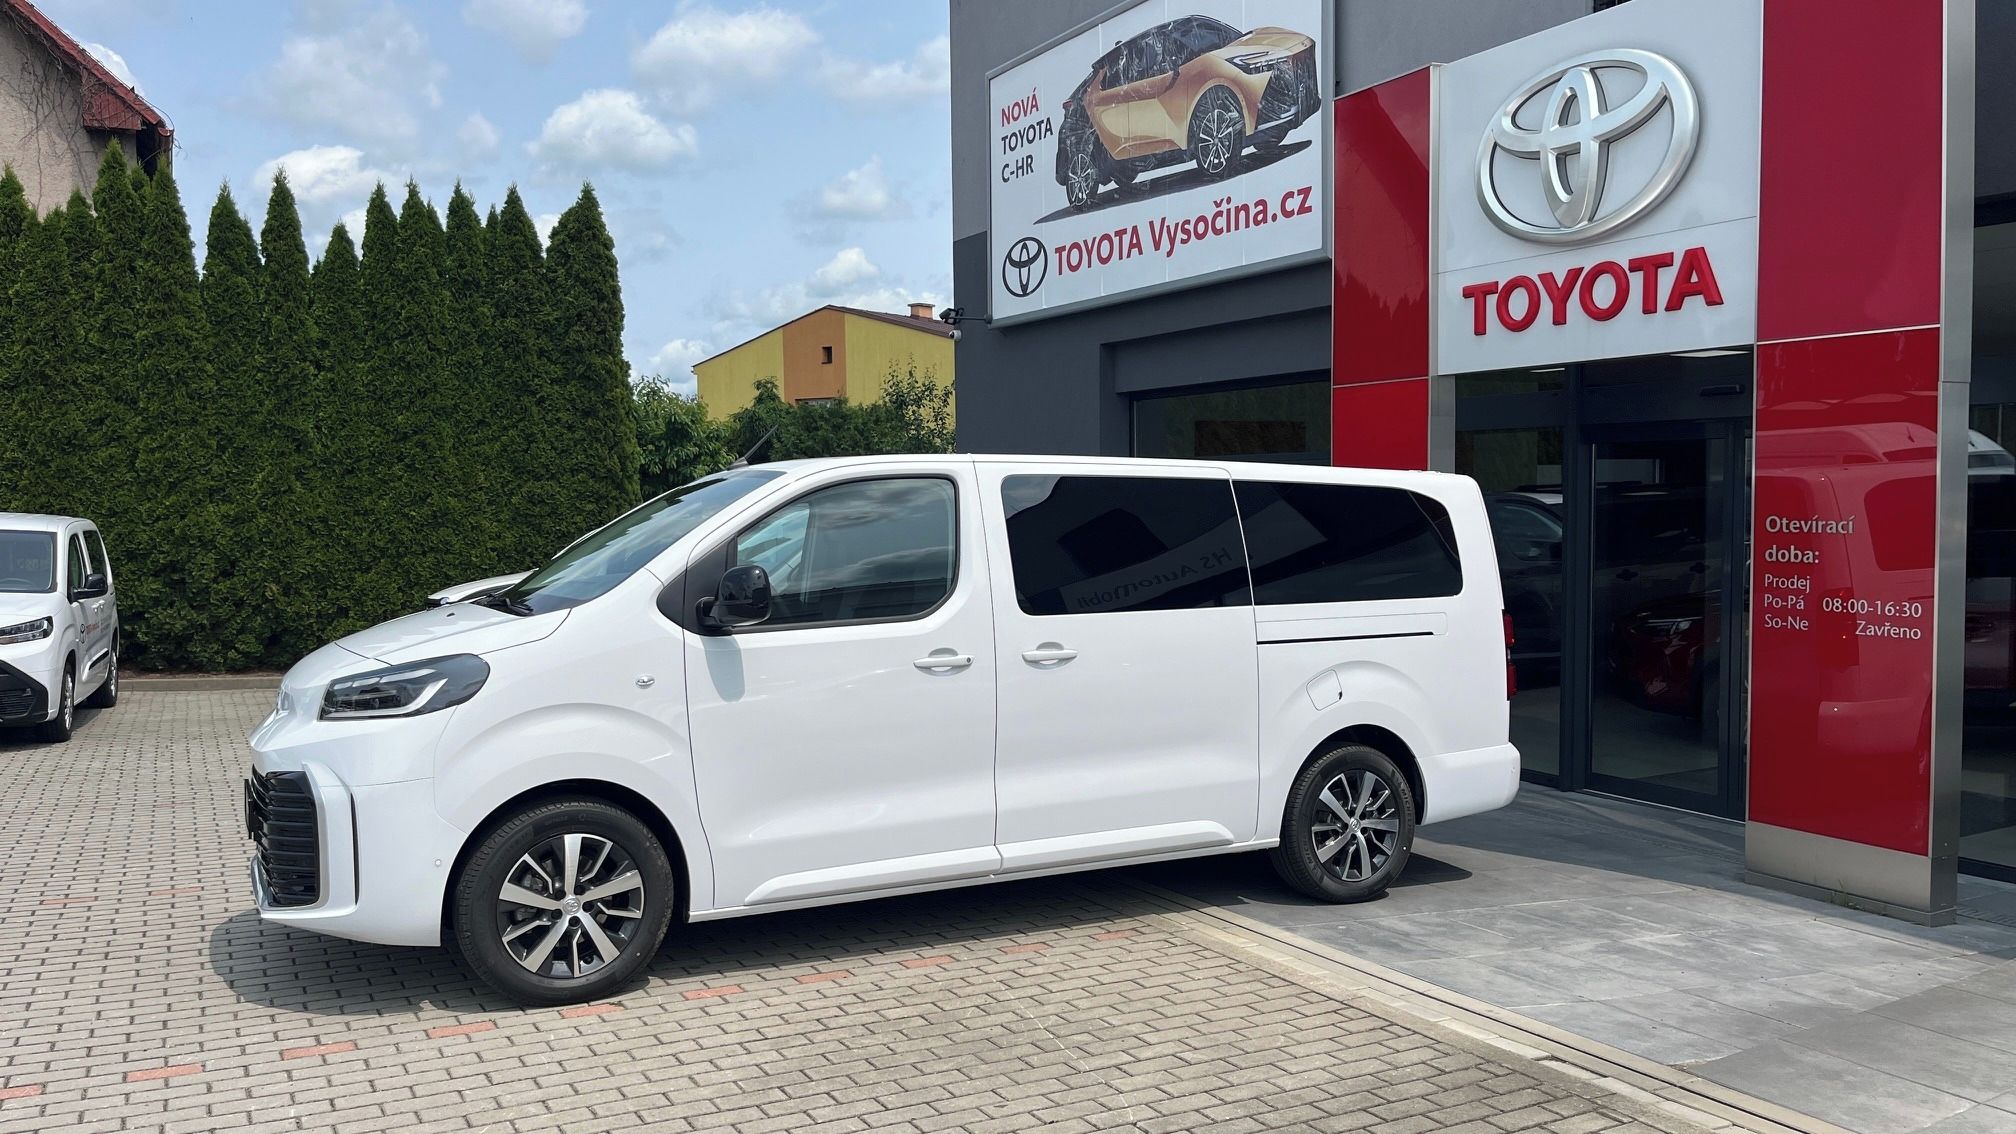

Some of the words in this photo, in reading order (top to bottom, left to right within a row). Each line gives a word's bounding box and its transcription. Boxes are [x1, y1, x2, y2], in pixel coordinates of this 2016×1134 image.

[1001, 87, 1039, 127] NOVÁ
[1001, 117, 1053, 155] TOYOTA
[1001, 156, 1034, 184] C-HR
[1054, 225, 1144, 276] TOYOTA
[1149, 186, 1313, 257] Vysočina.cz
[1462, 246, 1724, 336] TOYOTA
[1765, 515, 1856, 534] Otevírací
[1764, 544, 1820, 564] doba:
[1764, 574, 1811, 594] Prodej
[1764, 593, 1805, 610] Po-Pá
[1822, 597, 1922, 618] 08:00-16:30
[1764, 614, 1809, 631] So-Ne
[1855, 620, 1921, 640] Zavřeno
